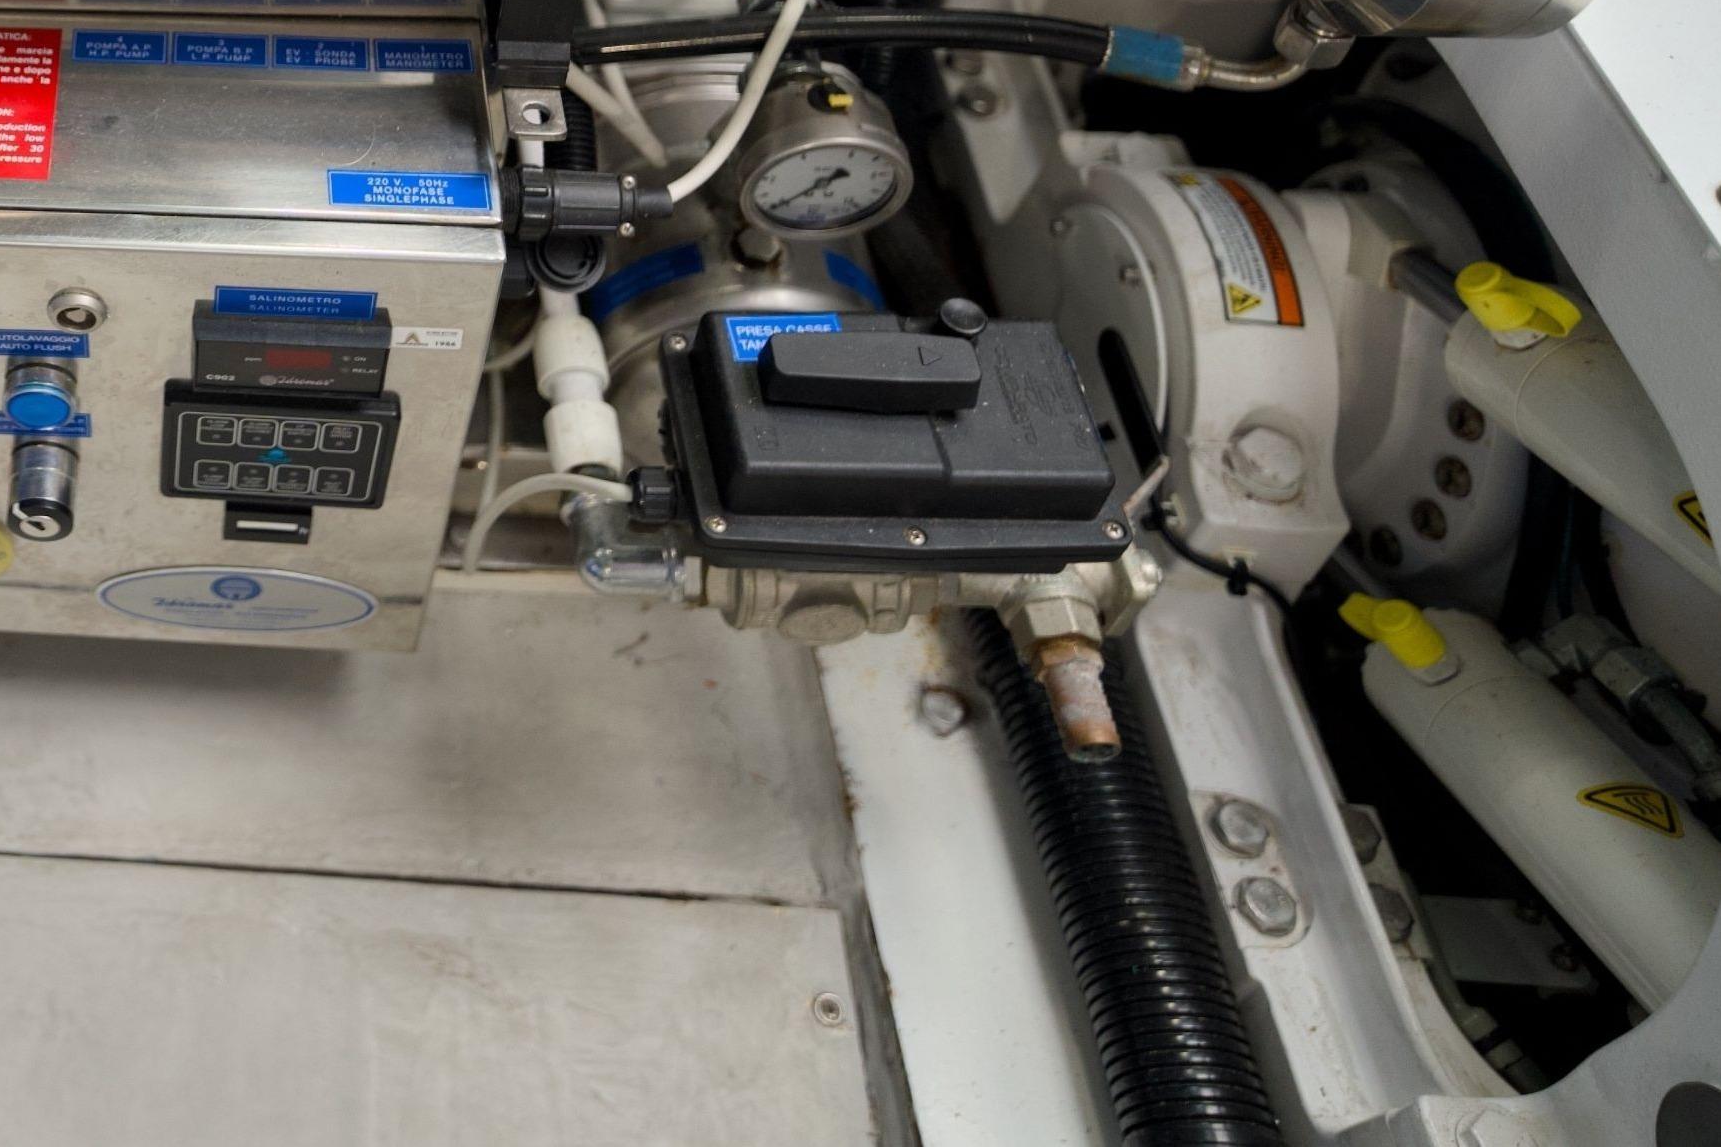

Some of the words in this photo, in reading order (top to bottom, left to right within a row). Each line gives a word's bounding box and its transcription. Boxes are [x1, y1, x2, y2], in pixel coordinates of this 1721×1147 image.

[16, 46, 53, 55] marcia
[86, 42, 127, 50] POMPA
[187, 45, 228, 53] POMPA
[115, 50, 150, 59] PUMP
[216, 54, 251, 62] PUMP
[285, 48, 300, 56] EV
[315, 49, 356, 58] SONDA
[385, 52, 464, 60] MANOMETRO
[42, 56, 52, 65] la
[285, 56, 300, 64] EV
[315, 58, 357, 66] PROBE
[385, 60, 464, 68] MANOMETER
[23, 66, 52, 76] dopo
[0, 75, 34, 84] anche
[40, 76, 51, 85] la
[25, 133, 45, 143] low
[29, 144, 44, 153] 30
[367, 177, 389, 186] 220
[393, 178, 404, 187] V.
[373, 186, 444, 196] MONOFASE
[364, 194, 454, 205] SINGLEPHASE
[249, 294, 342, 305] SALINOMETRO
[249, 304, 340, 314] SALINOMETER
[736, 325, 781, 336] PRESA
[0, 342, 31, 351] AUTO
[33, 343, 72, 352] FLUSH
